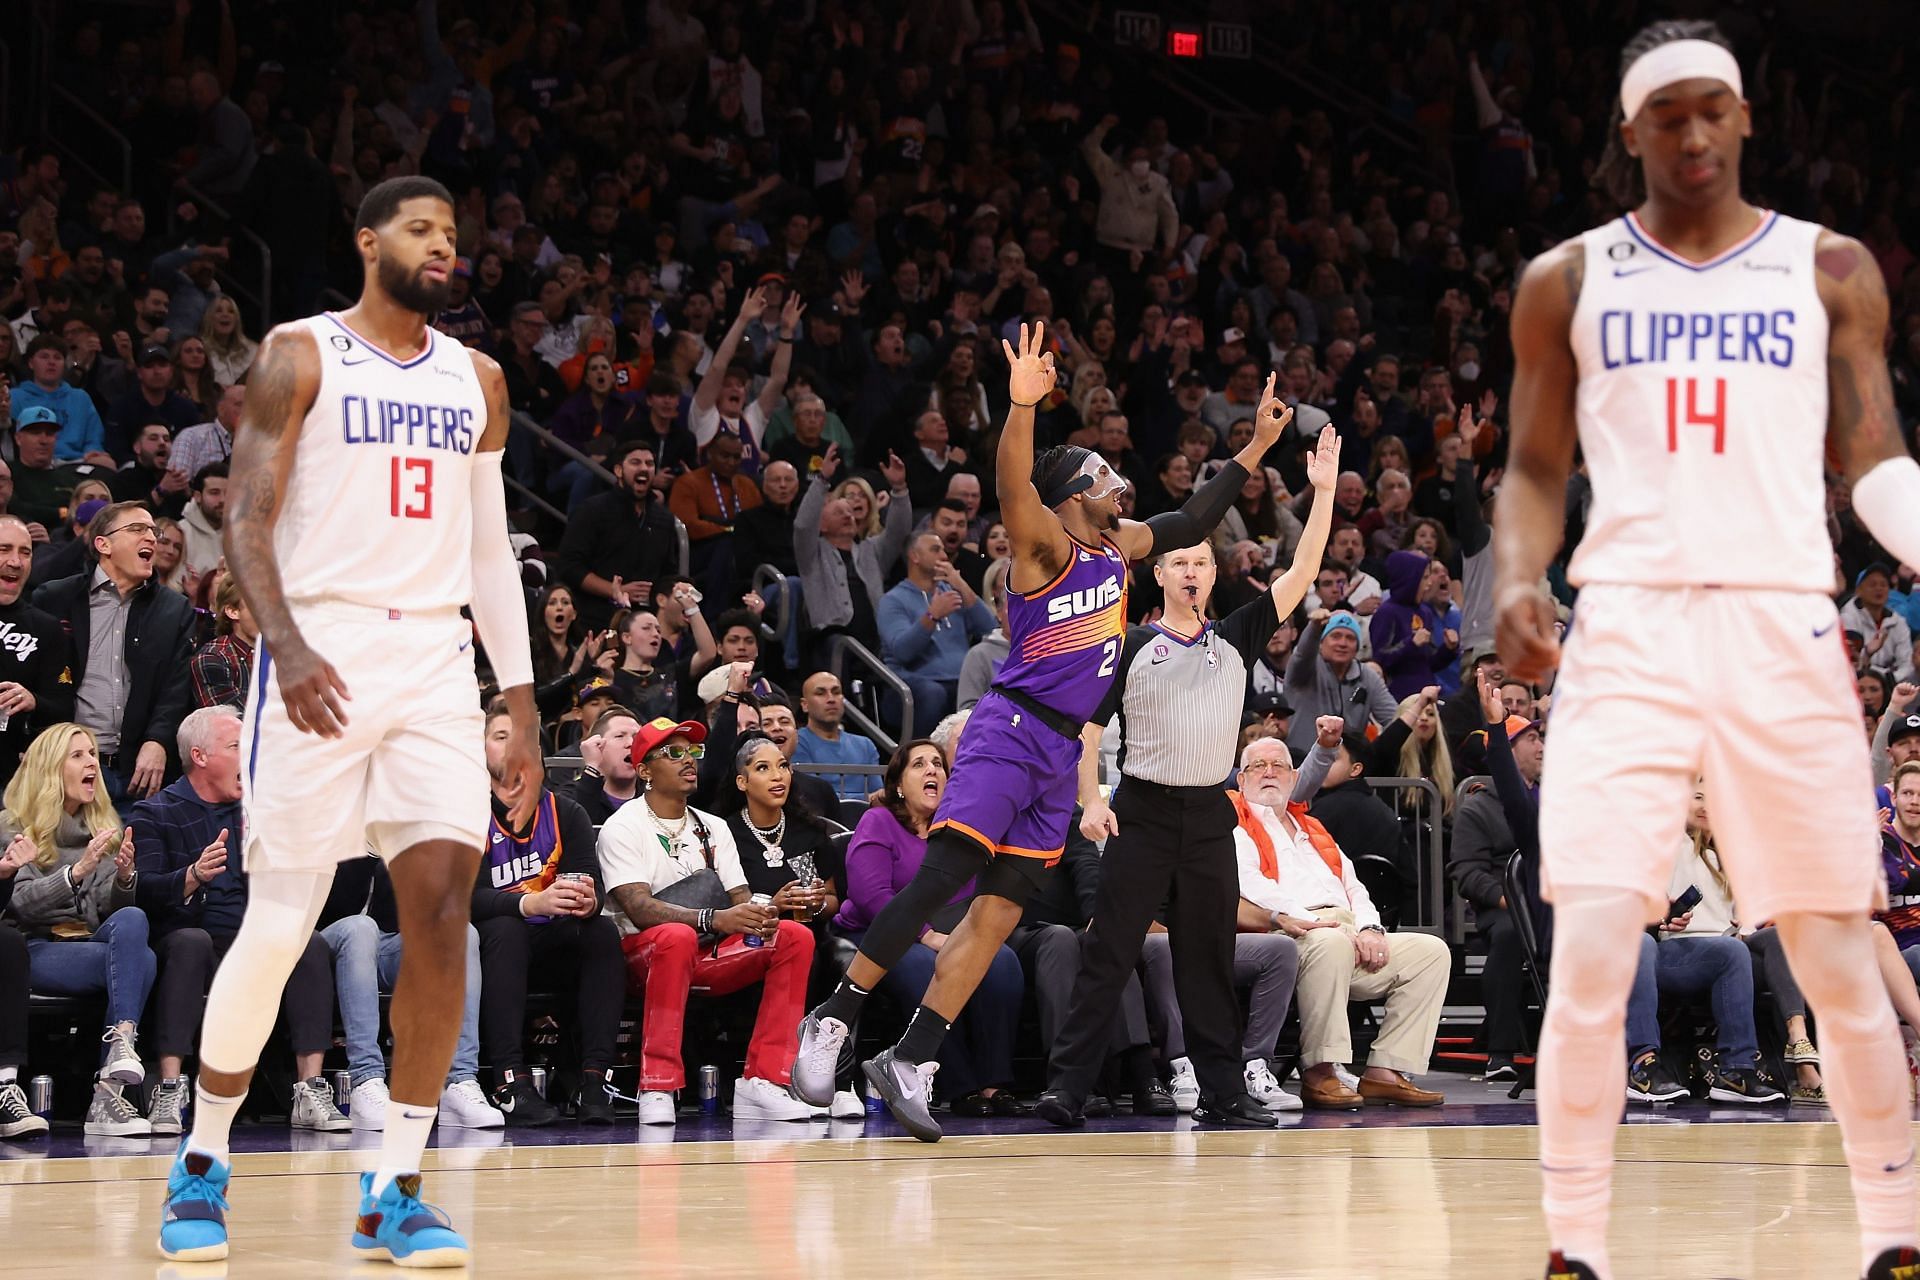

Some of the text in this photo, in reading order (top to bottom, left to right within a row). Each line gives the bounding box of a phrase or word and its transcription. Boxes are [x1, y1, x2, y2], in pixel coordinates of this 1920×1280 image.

[1216, 28, 1244, 51] 115
[1600, 310, 1796, 371] CLIPPERS
[342, 394, 473, 455] CLIPPERS
[1666, 377, 1727, 455] 14
[391, 456, 433, 519] 13
[1047, 574, 1122, 623] SUNS
